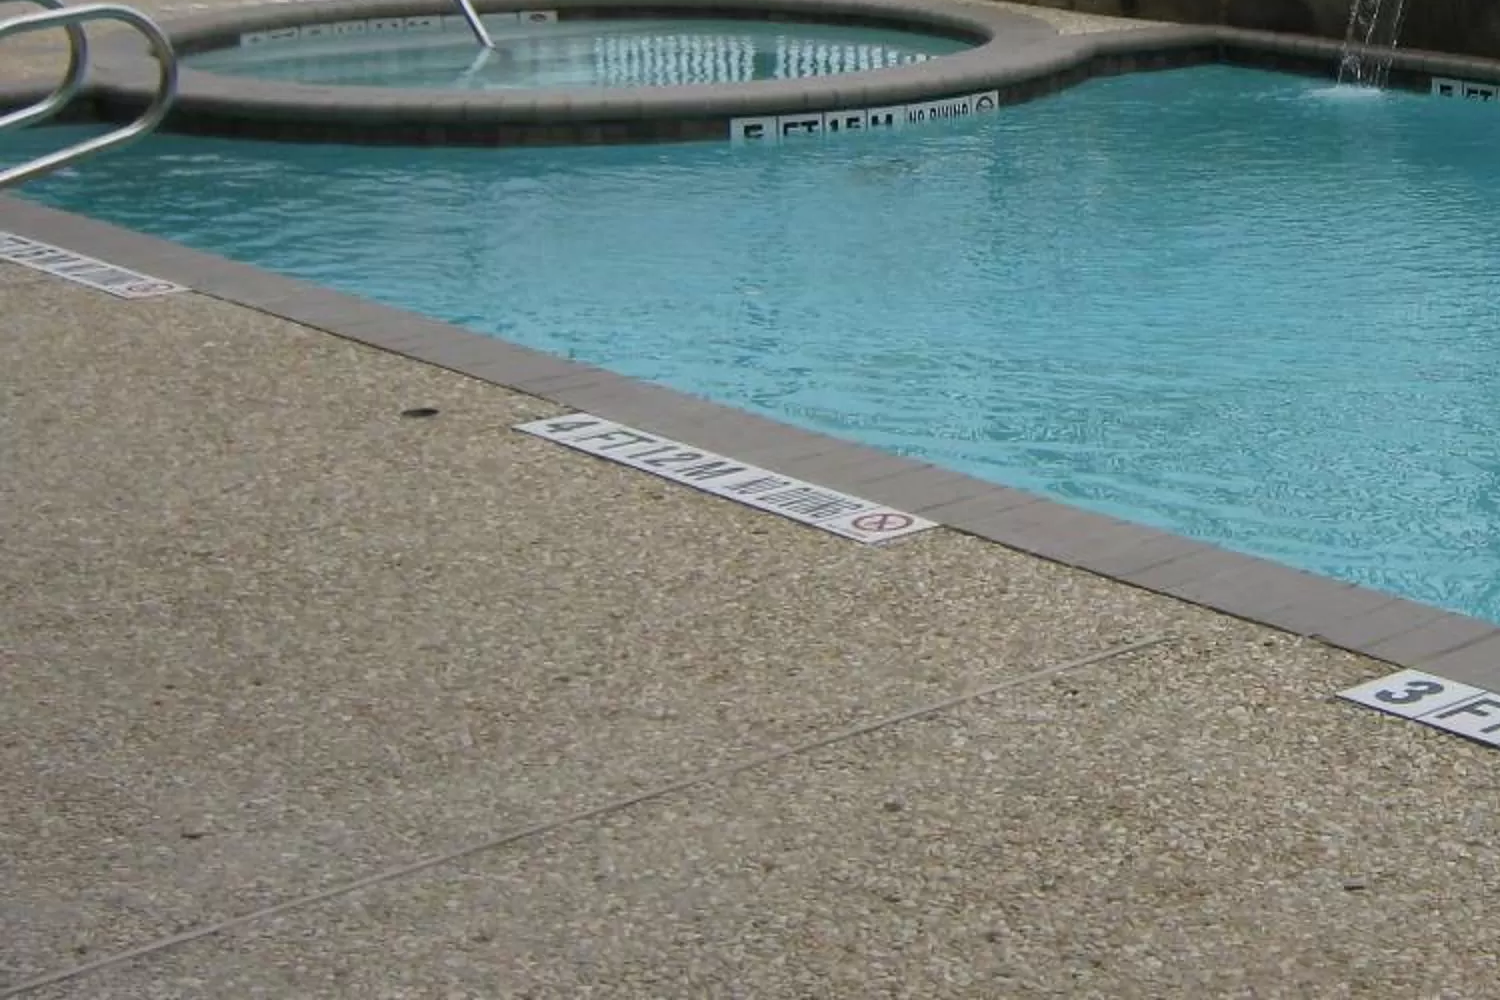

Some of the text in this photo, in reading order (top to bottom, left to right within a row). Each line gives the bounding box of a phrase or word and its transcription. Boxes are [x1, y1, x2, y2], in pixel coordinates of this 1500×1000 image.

[546, 421, 601, 434] 4
[573, 431, 658, 451] FT
[674, 461, 749, 481] M
[1375, 681, 1445, 705] 3
